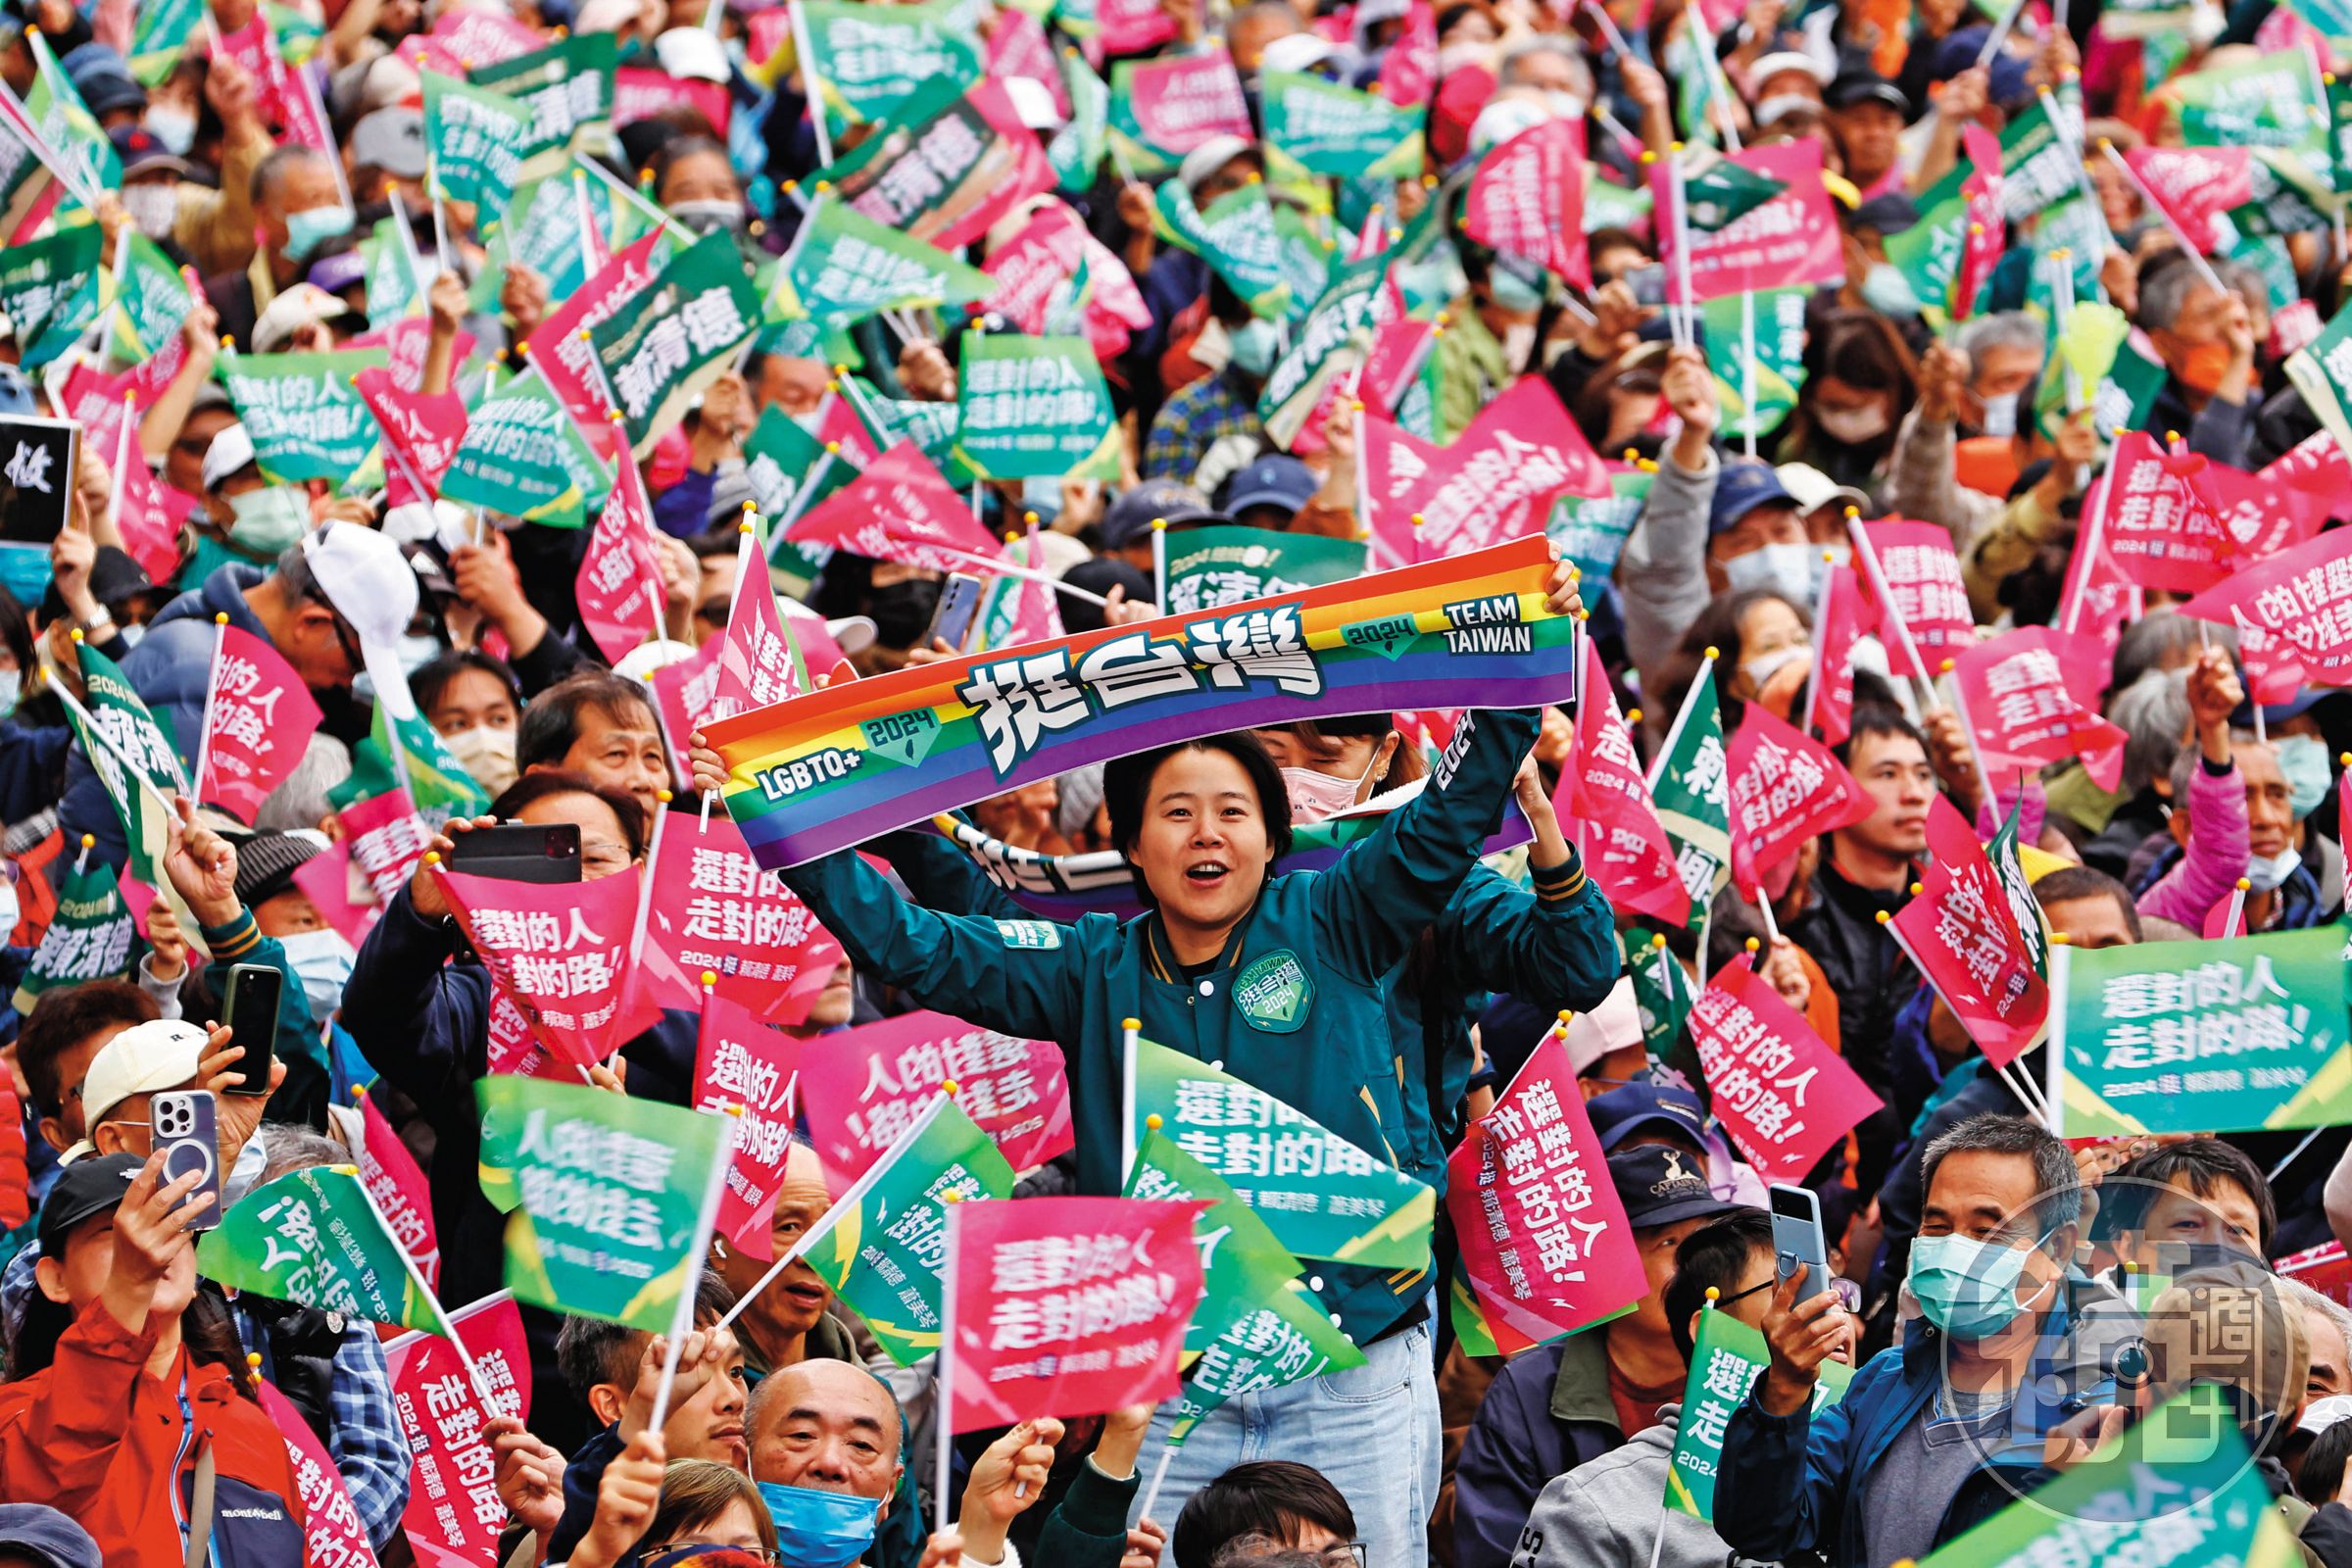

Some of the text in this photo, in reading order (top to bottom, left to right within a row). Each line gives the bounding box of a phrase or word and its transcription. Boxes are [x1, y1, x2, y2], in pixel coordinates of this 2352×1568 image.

[1348, 618, 1417, 648] 2024
[1446, 595, 1518, 625] TEAM
[1447, 624, 1533, 655] TAIWAN
[964, 607, 1321, 776] 挺台灣
[866, 709, 933, 747] 2024
[1434, 710, 1475, 791] 2024
[759, 749, 861, 801] LGBTQ+
[689, 847, 800, 901] 選對的
[30, 913, 133, 979] 賴清德
[469, 906, 605, 955] 選對的人
[682, 897, 821, 948] 走對的路!
[1237, 956, 1290, 993] TEAM TAIWAN
[1238, 958, 1304, 1015] 挺台灣
[1262, 986, 1296, 1013] 2024
[2102, 955, 2290, 1018] 選對的人
[2101, 1003, 2312, 1070] 走對的路!
[1480, 1104, 1587, 1284] 走對的路!
[1515, 1078, 1608, 1259] 選對的人
[991, 1228, 1154, 1293] 選對的人
[989, 1272, 1176, 1350] 走對的路!
